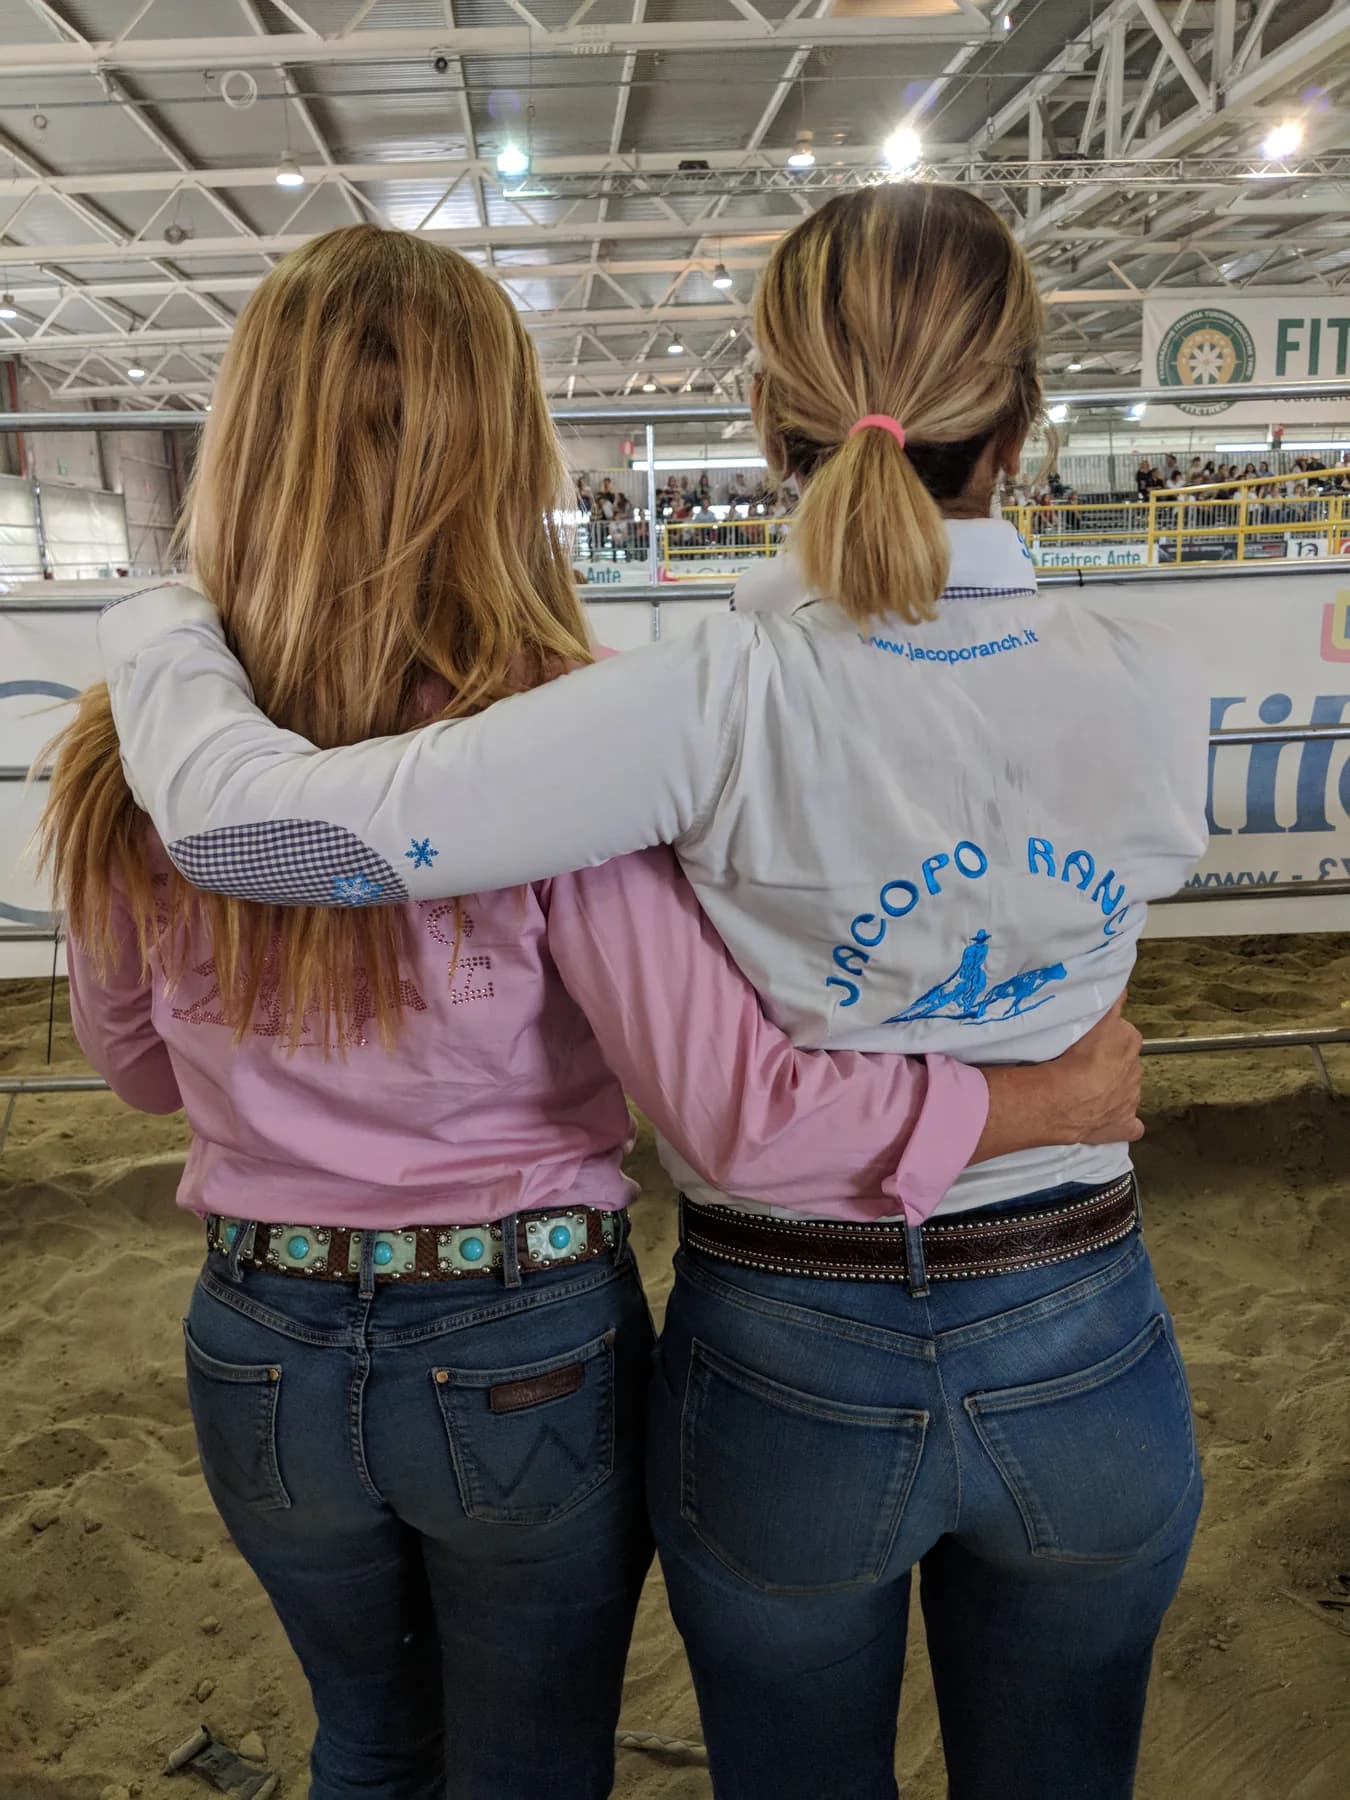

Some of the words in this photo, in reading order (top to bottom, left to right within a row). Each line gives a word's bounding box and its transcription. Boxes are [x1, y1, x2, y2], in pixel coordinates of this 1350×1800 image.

[1041, 551, 1102, 567] Fitetrec
[1107, 550, 1141, 566] Ante
[586, 566, 622, 583] Ante
[826, 840, 989, 1007] JACOPO
[1027, 836, 1130, 937] RANC
